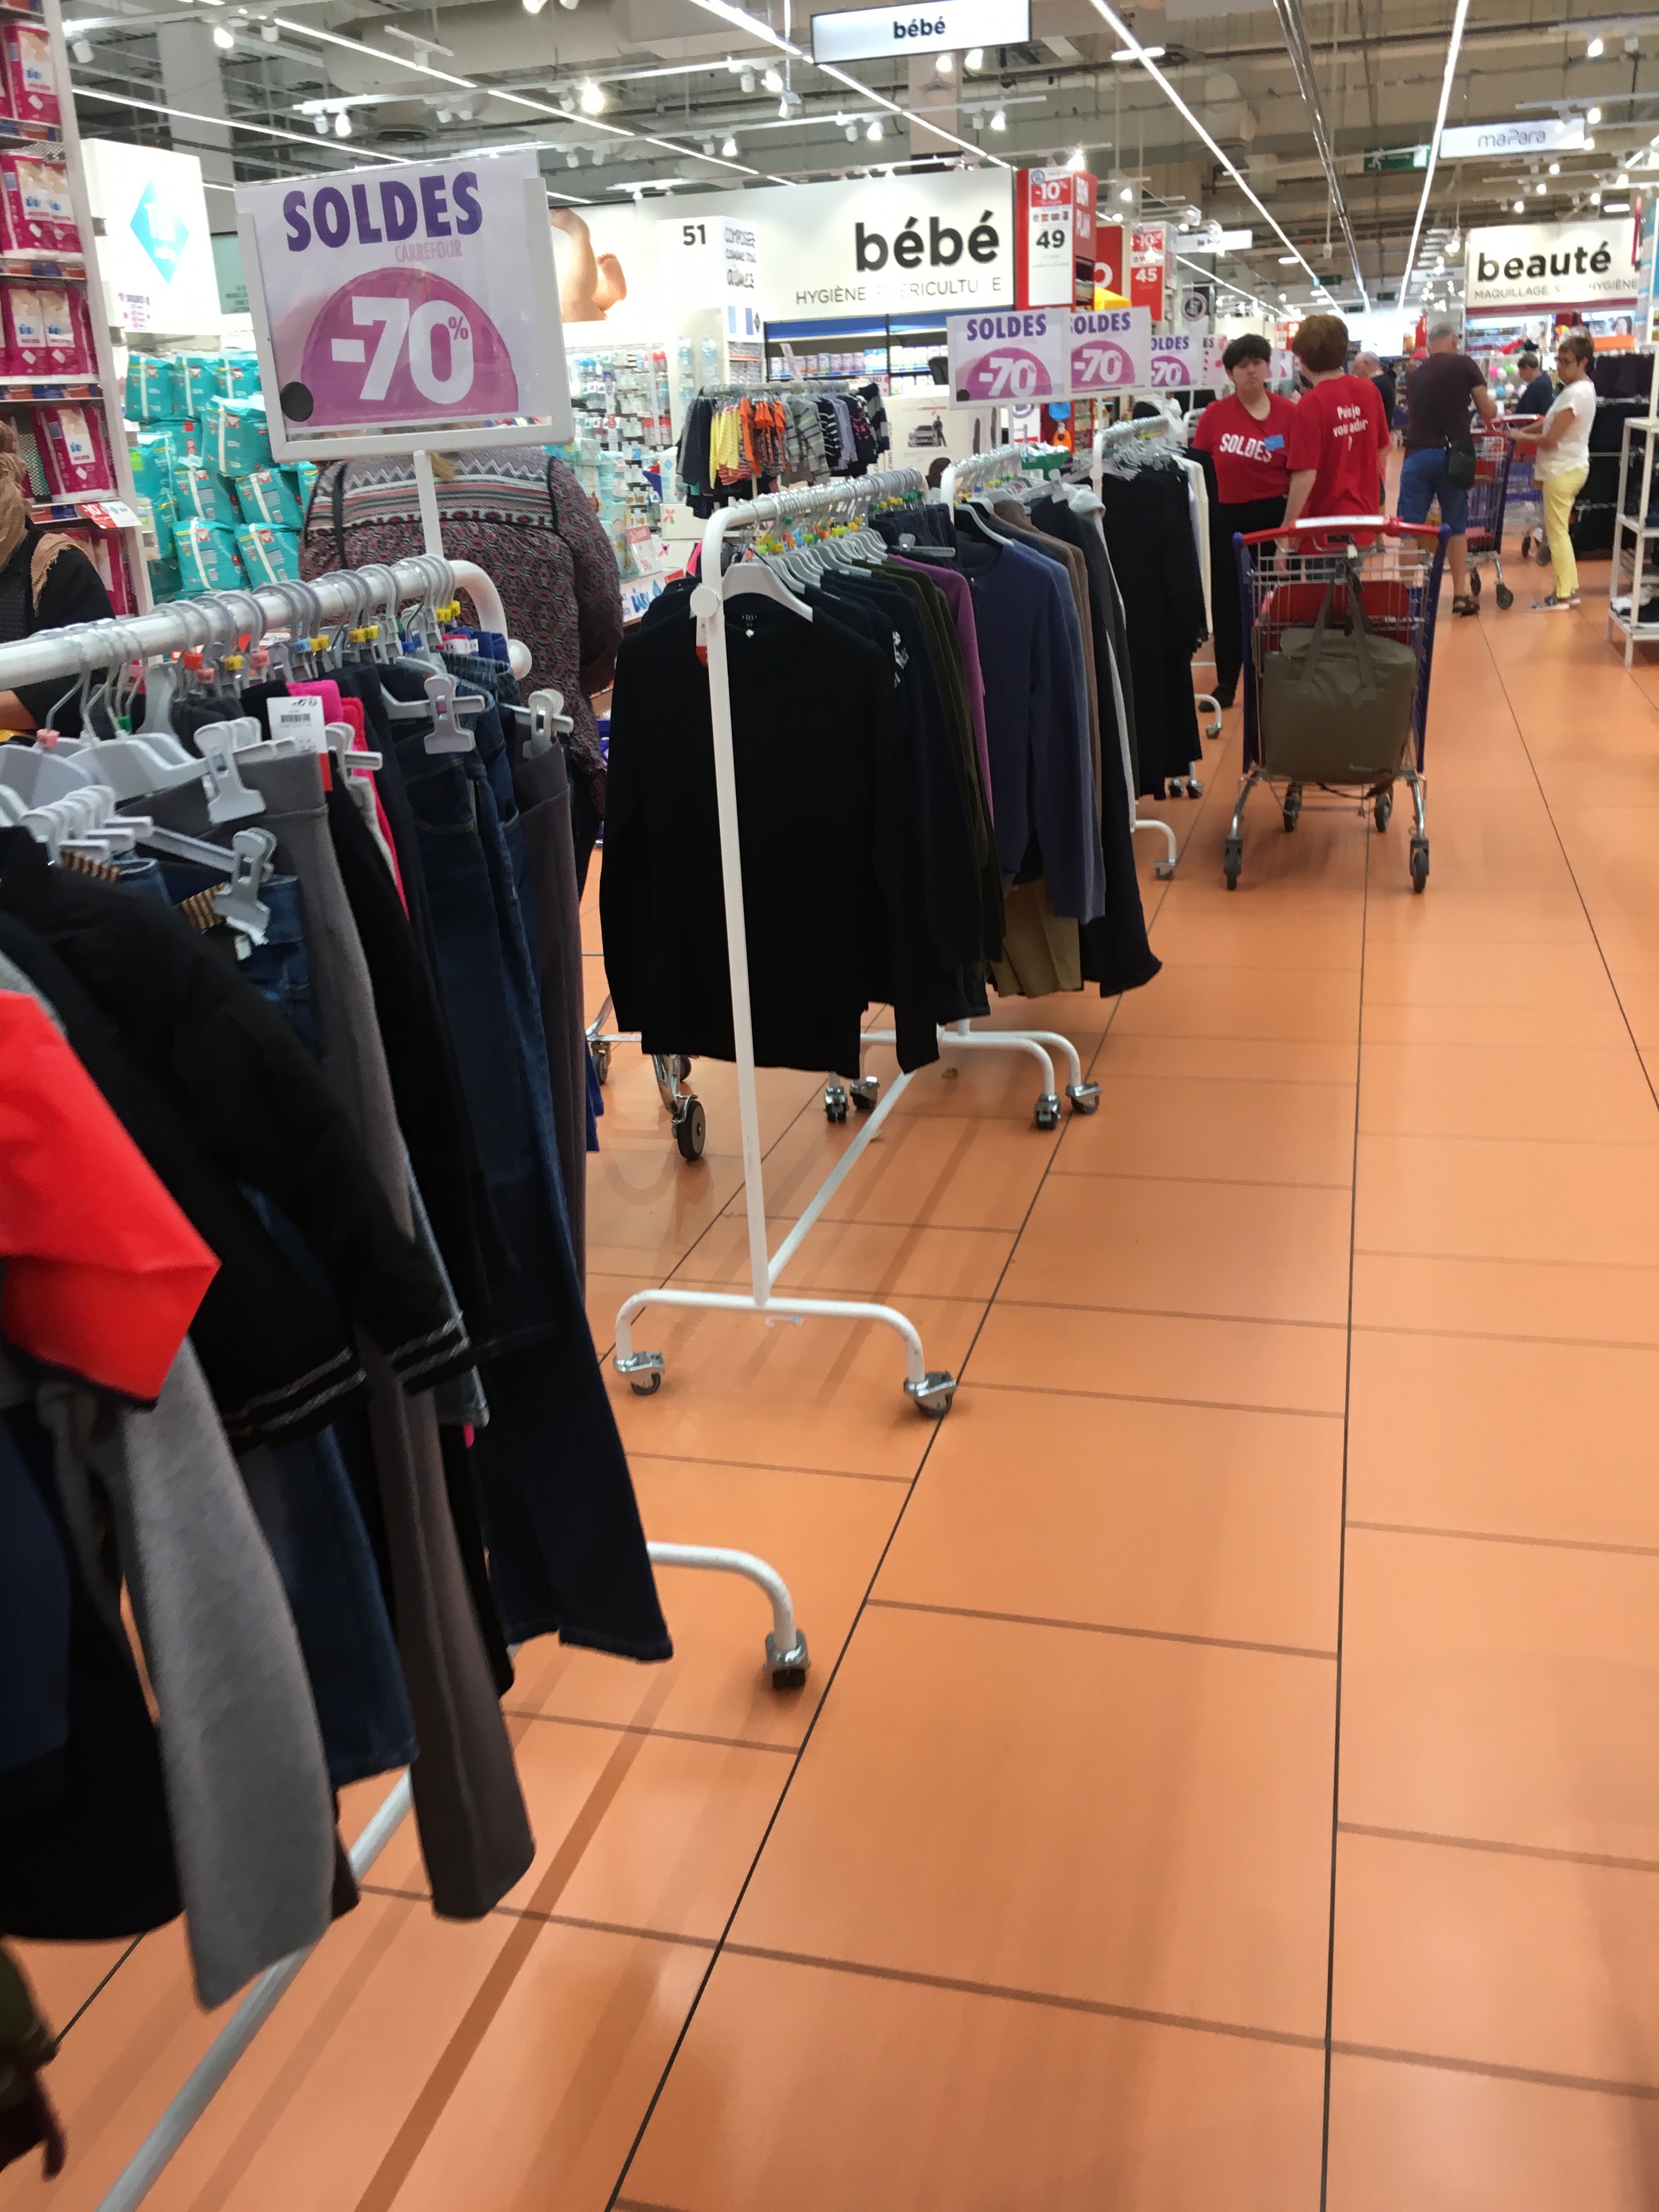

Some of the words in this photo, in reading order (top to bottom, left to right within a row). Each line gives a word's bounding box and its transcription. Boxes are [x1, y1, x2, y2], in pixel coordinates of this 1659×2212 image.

[893, 15, 945, 39] bébé
[283, 172, 482, 252] SOLDES
[682, 224, 706, 246] 51
[855, 210, 1000, 272] bébé
[1036, 229, 1065, 249] 49
[394, 239, 464, 263] CARREFOUR
[1477, 240, 1611, 283] beauté
[1136, 268, 1158, 283] 45
[795, 285, 866, 305] HYGIÈNE
[878, 276, 1001, 297] RICULTUE
[967, 313, 1047, 341] SOLDES
[1070, 311, 1131, 335] OLDES
[331, 296, 474, 404] -70%
[1151, 335, 1189, 351] OLDES
[1219, 433, 1272, 462] SOLDES
